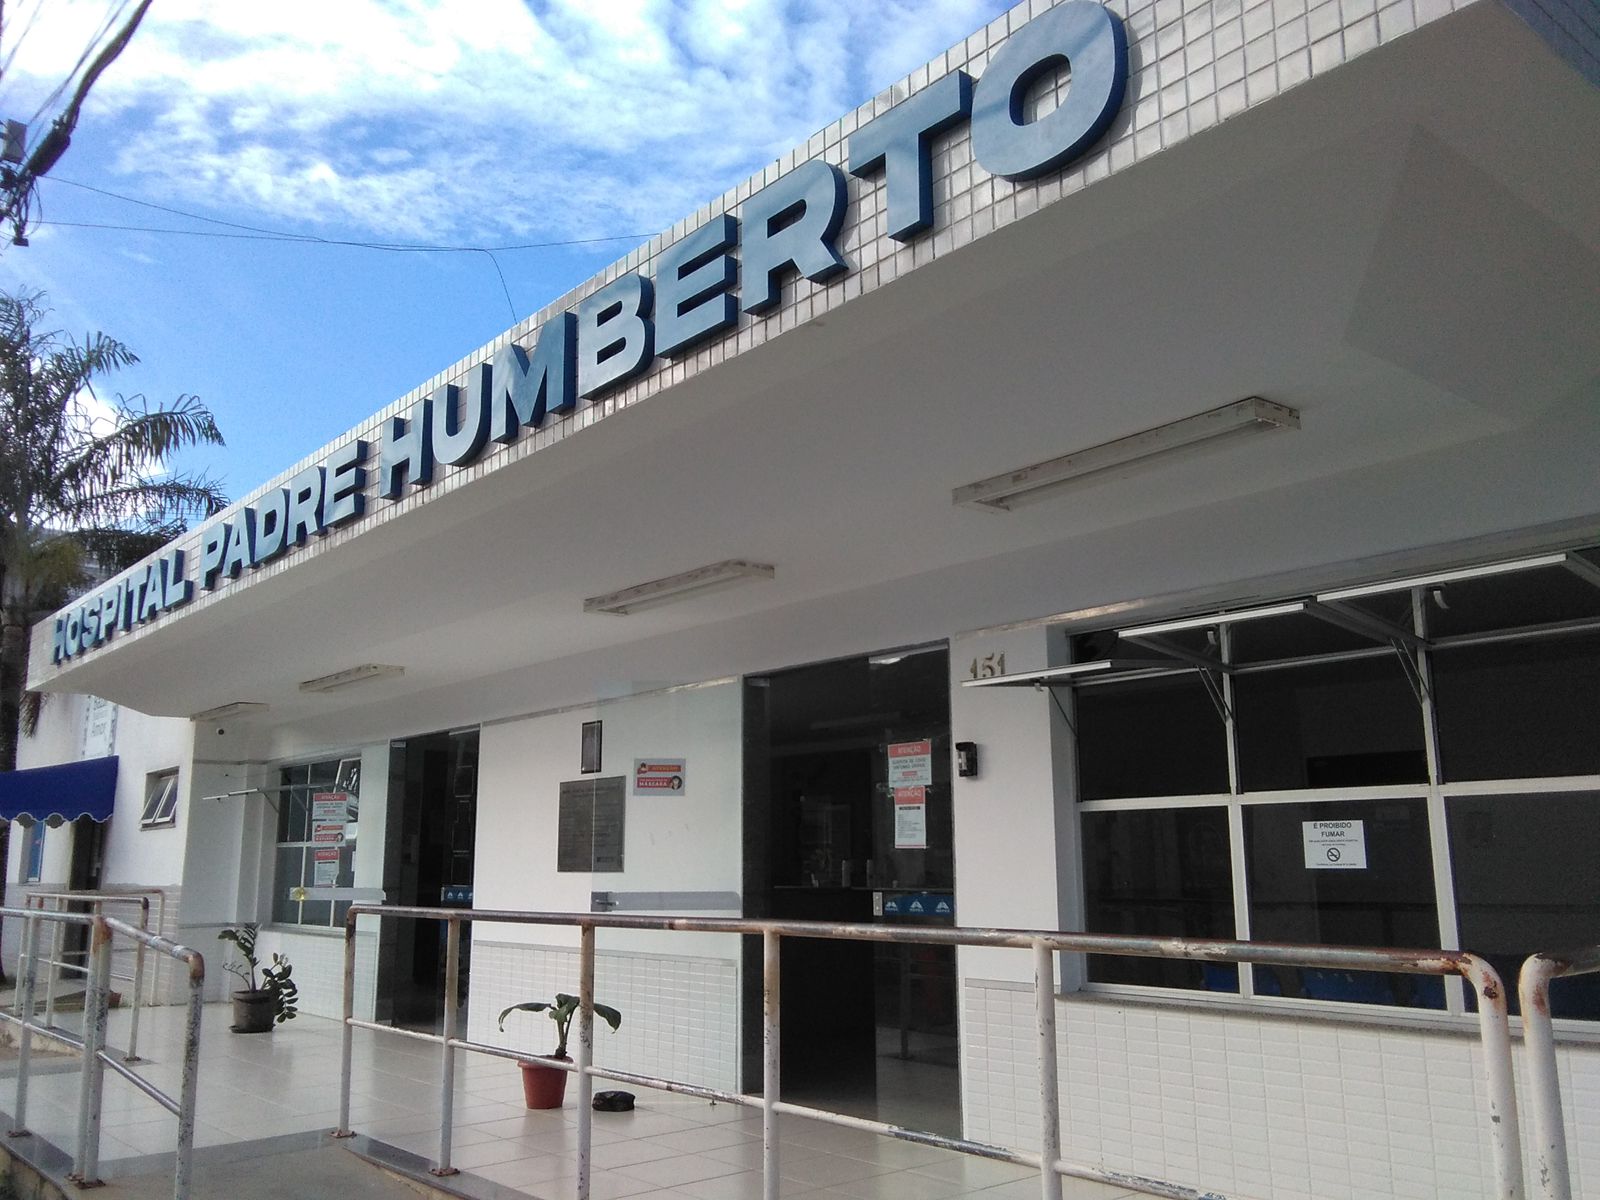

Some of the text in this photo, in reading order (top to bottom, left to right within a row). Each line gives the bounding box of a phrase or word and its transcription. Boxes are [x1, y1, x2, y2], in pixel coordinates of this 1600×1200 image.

[51, 0, 1128, 667] HOSPITAL PADRE HUMBERTO
[970, 650, 1006, 679] 151
